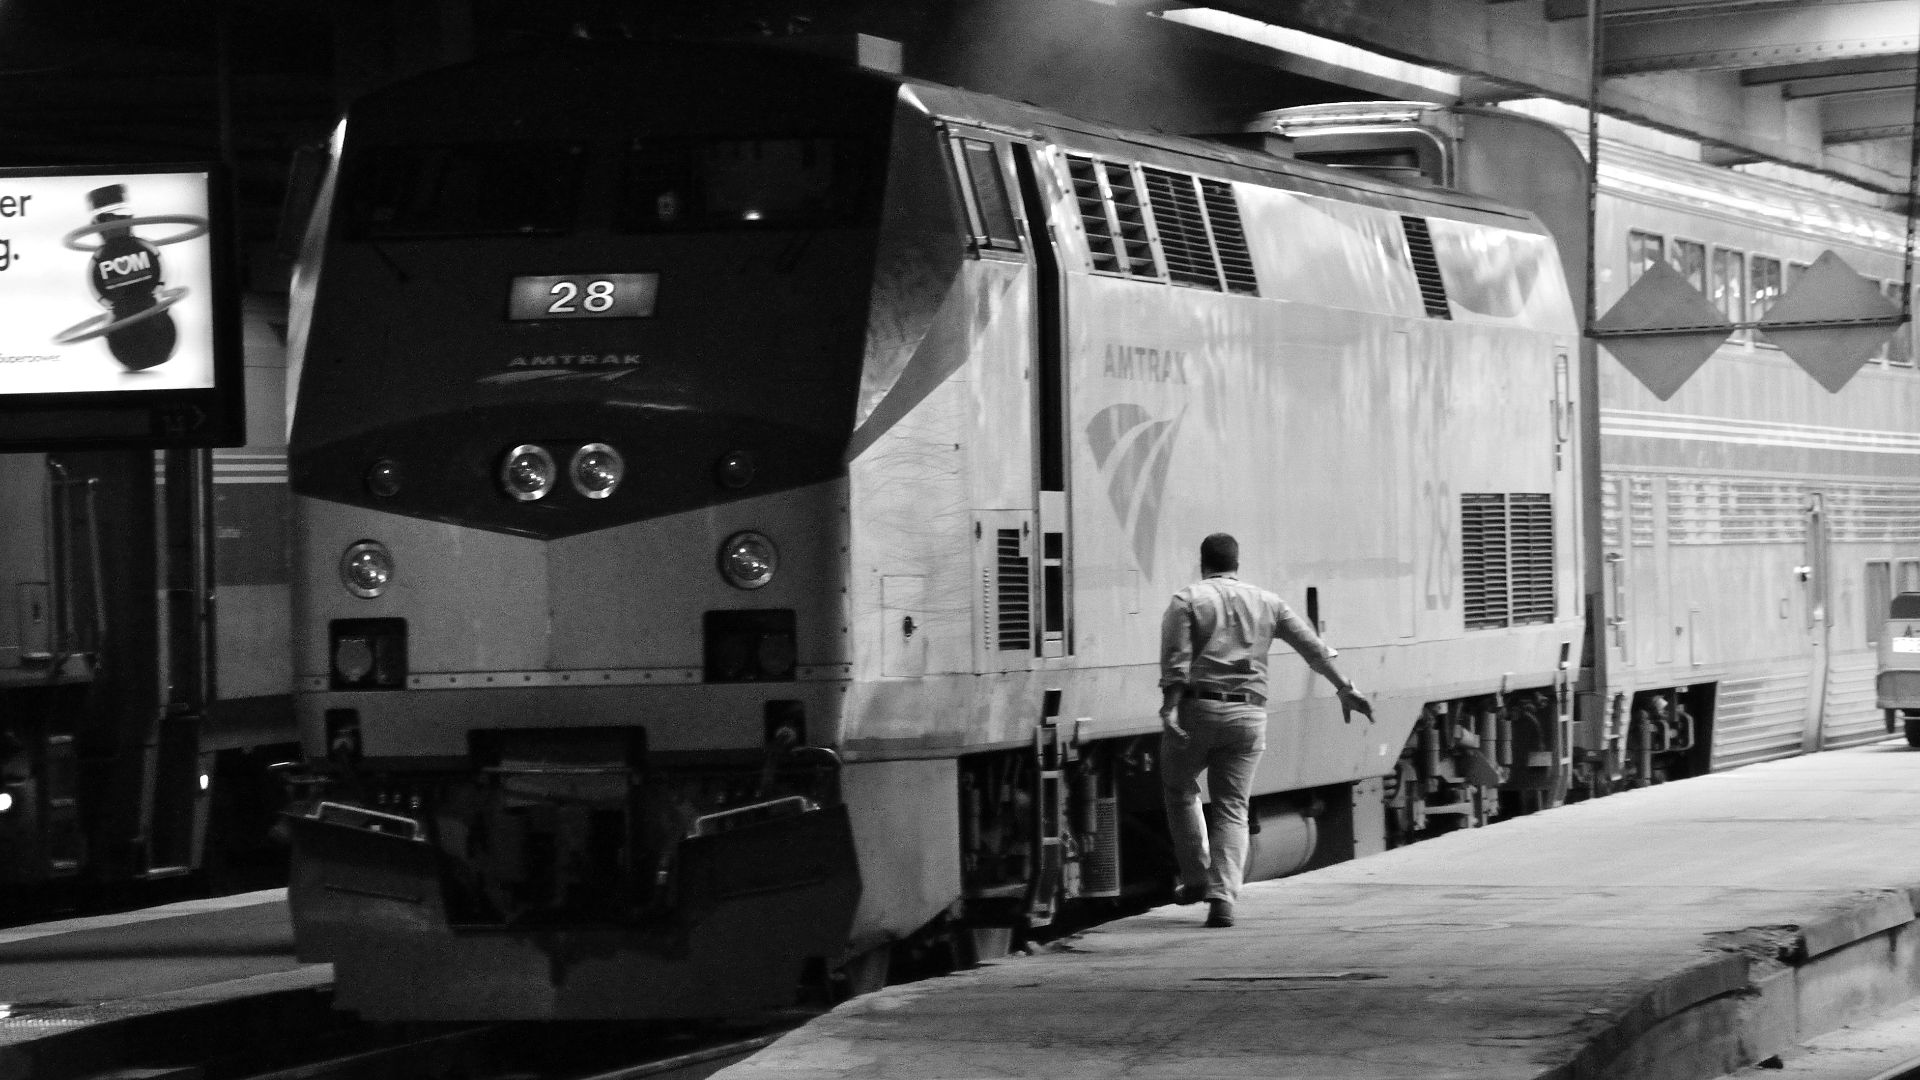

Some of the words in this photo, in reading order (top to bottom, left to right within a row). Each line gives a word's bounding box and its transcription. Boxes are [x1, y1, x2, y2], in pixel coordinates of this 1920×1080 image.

[99, 251, 151, 280] POM
[548, 280, 615, 313] 28
[508, 354, 641, 367] AMTRAK
